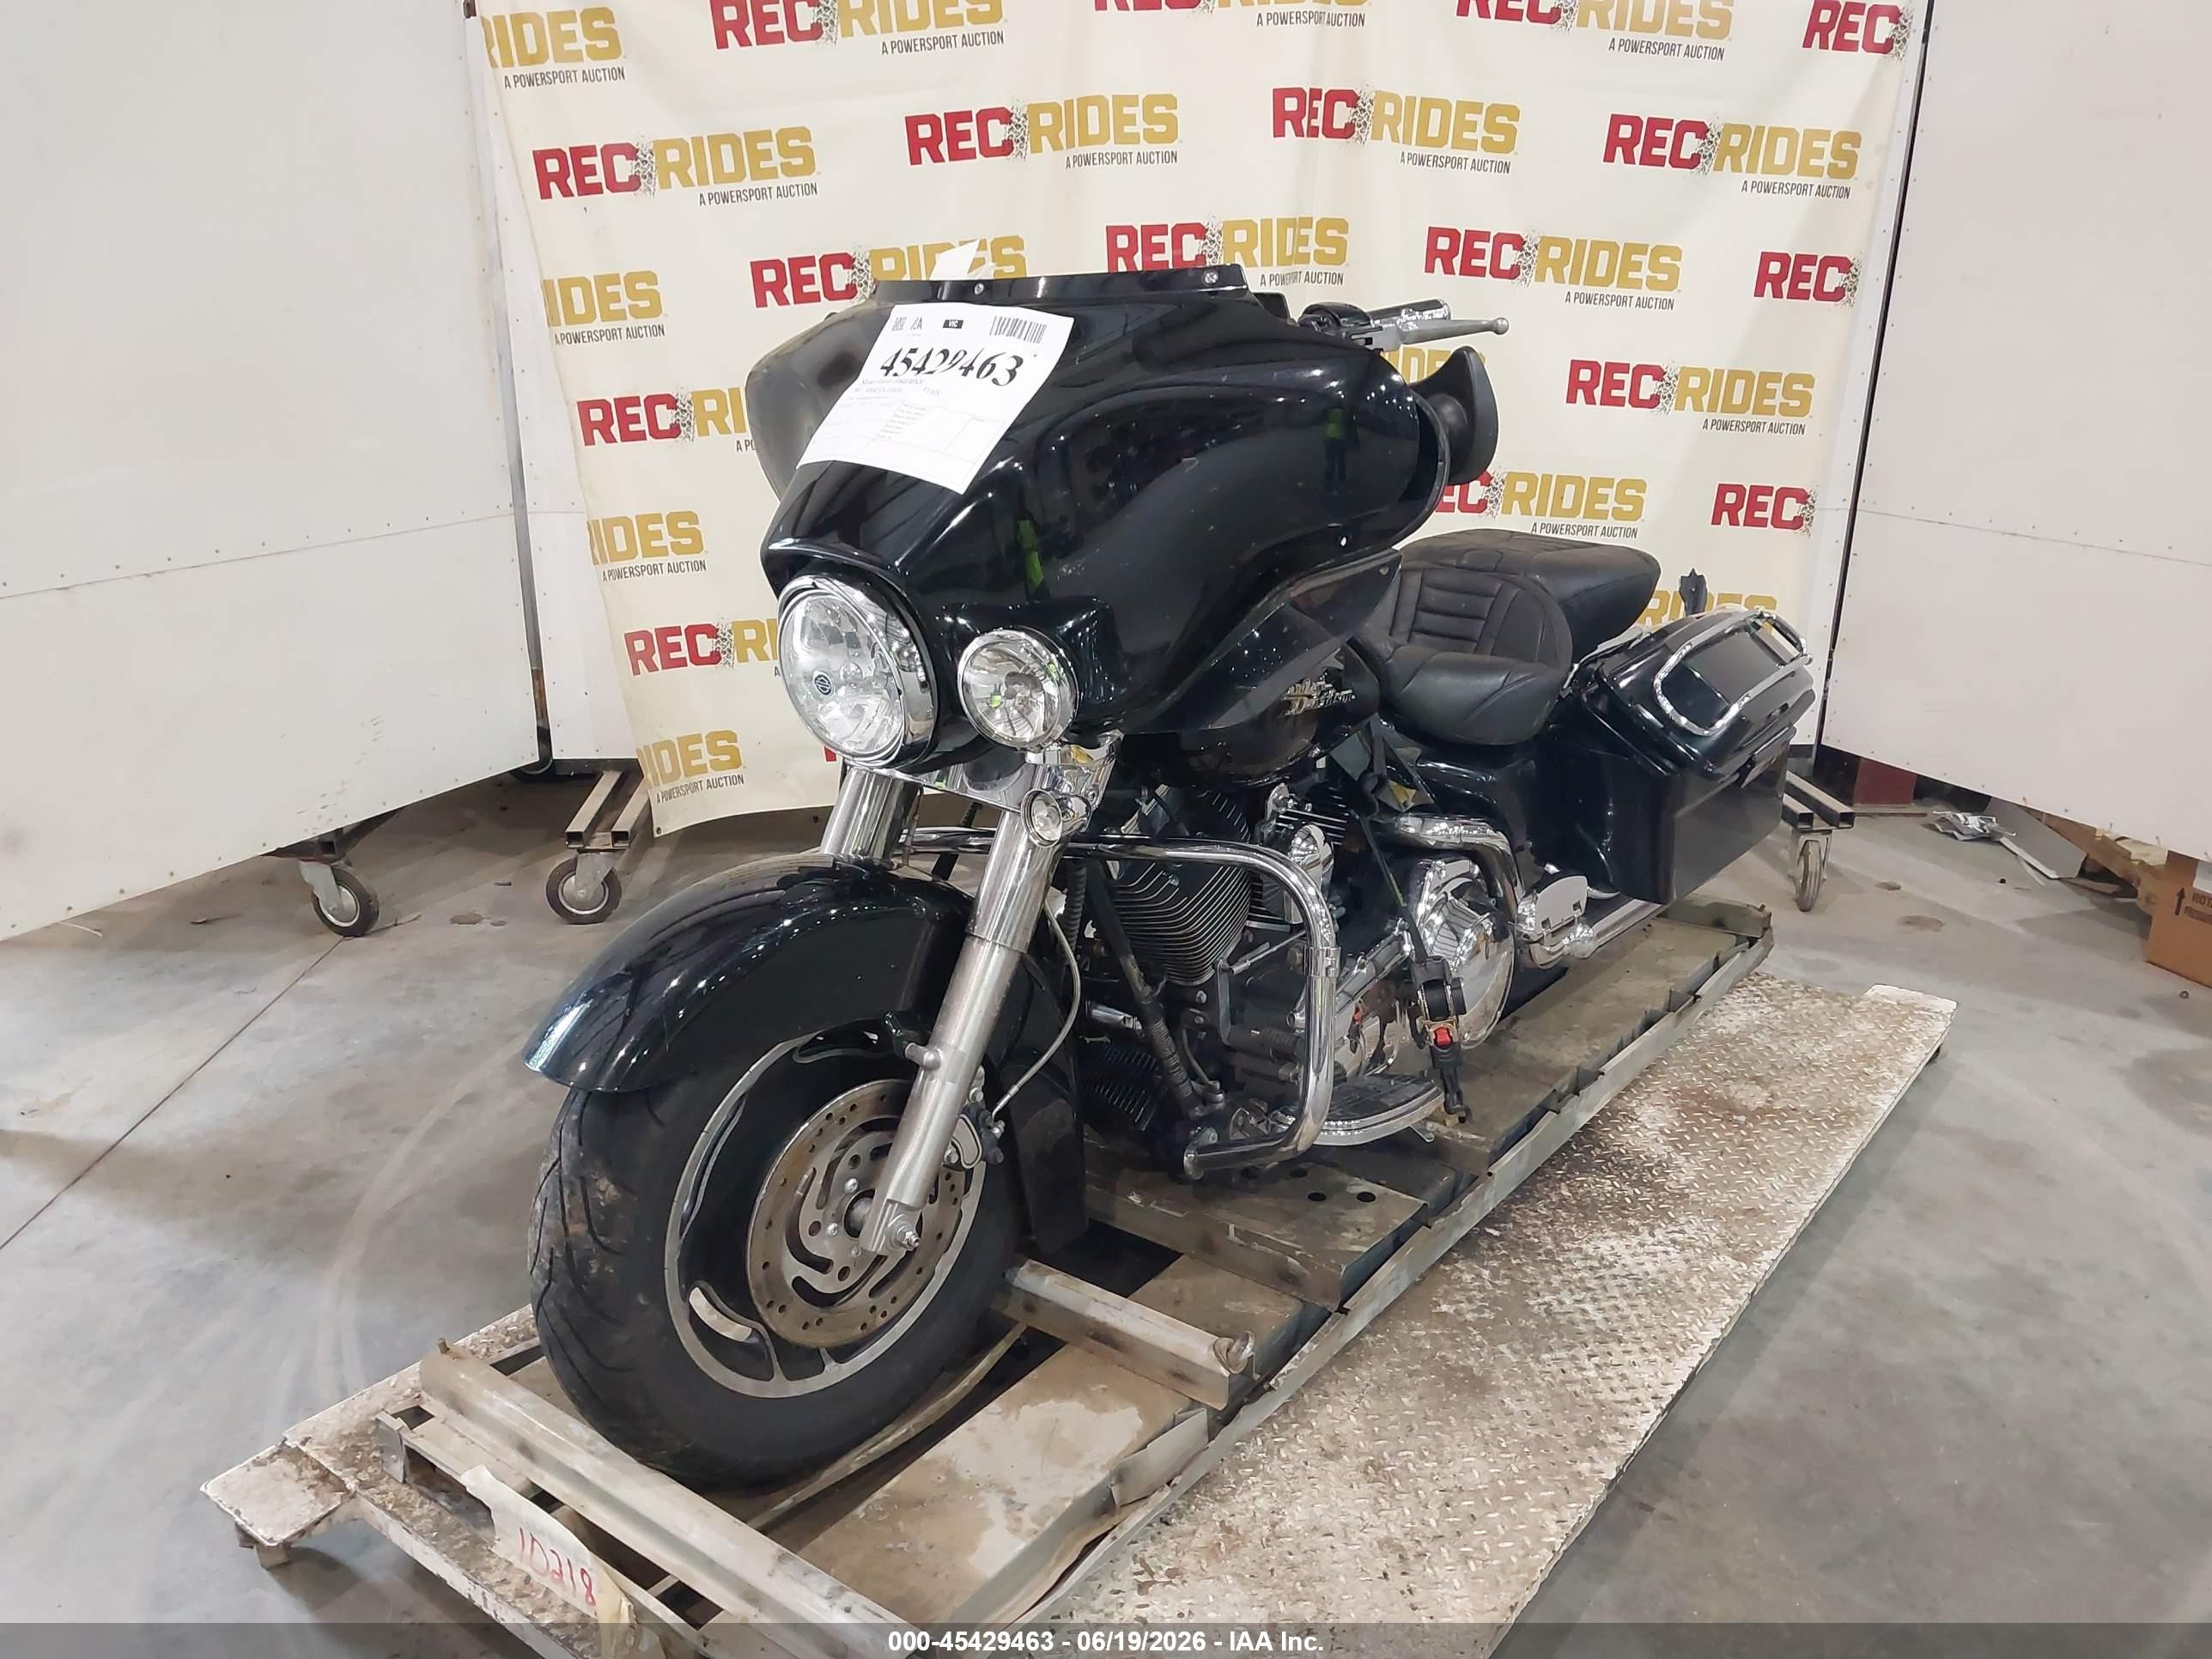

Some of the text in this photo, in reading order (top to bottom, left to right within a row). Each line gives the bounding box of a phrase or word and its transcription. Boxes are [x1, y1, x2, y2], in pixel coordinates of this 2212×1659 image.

[710, 0, 824, 49] REC
[881, 31, 1005, 55] A POWERSPORT AUCTION
[1256, 13, 1264, 27] A
[1326, 13, 1365, 27] AUCTION
[1802, 0, 1902, 54] REC
[1608, 38, 1725, 60] A POWERSPORT AUCTION
[504, 66, 626, 89] A POWERSPORT AUCTION
[904, 94, 1179, 166] REC RIDES
[1273, 87, 1520, 154] REC RIDES
[532, 126, 817, 200] REC RIDES
[1066, 150, 1177, 169] A POWERSPORT AUCTION
[1400, 150, 1511, 173] A POWERSPORT AUCTION
[1603, 113, 1863, 179] REC RIDES
[699, 182, 818, 207] A POWERSPORT AUCTION
[1741, 180, 1850, 199] A POWERSPORT AUCTION
[1106, 216, 1349, 273] REC RIDES
[1425, 227, 1683, 292] REC RIDES
[543, 270, 663, 327] IDES
[750, 252, 858, 308] REC
[1261, 273, 1267, 288] A
[1304, 270, 1344, 285] AUCTION
[1753, 251, 1853, 302] REC
[1565, 292, 1674, 310] A POWERSPORT AUCTION
[560, 328, 623, 345] POWERSPORT
[626, 324, 665, 339] AUCTION
[880, 346, 1024, 386] 45429463
[1565, 360, 1816, 418] REC RIDES
[577, 393, 682, 447] REC
[1702, 419, 1805, 435] A POWERSPORT AUCTION
[1501, 471, 1648, 522] RIDES
[1711, 483, 1811, 531] REC
[586, 511, 704, 565] IDES
[1531, 522, 1638, 538] A POWERSPORT AUCTION
[608, 562, 665, 581] POWERSPORT
[667, 559, 707, 574] AUCTION
[624, 623, 722, 676] REC
[706, 774, 744, 791] AUCTION
